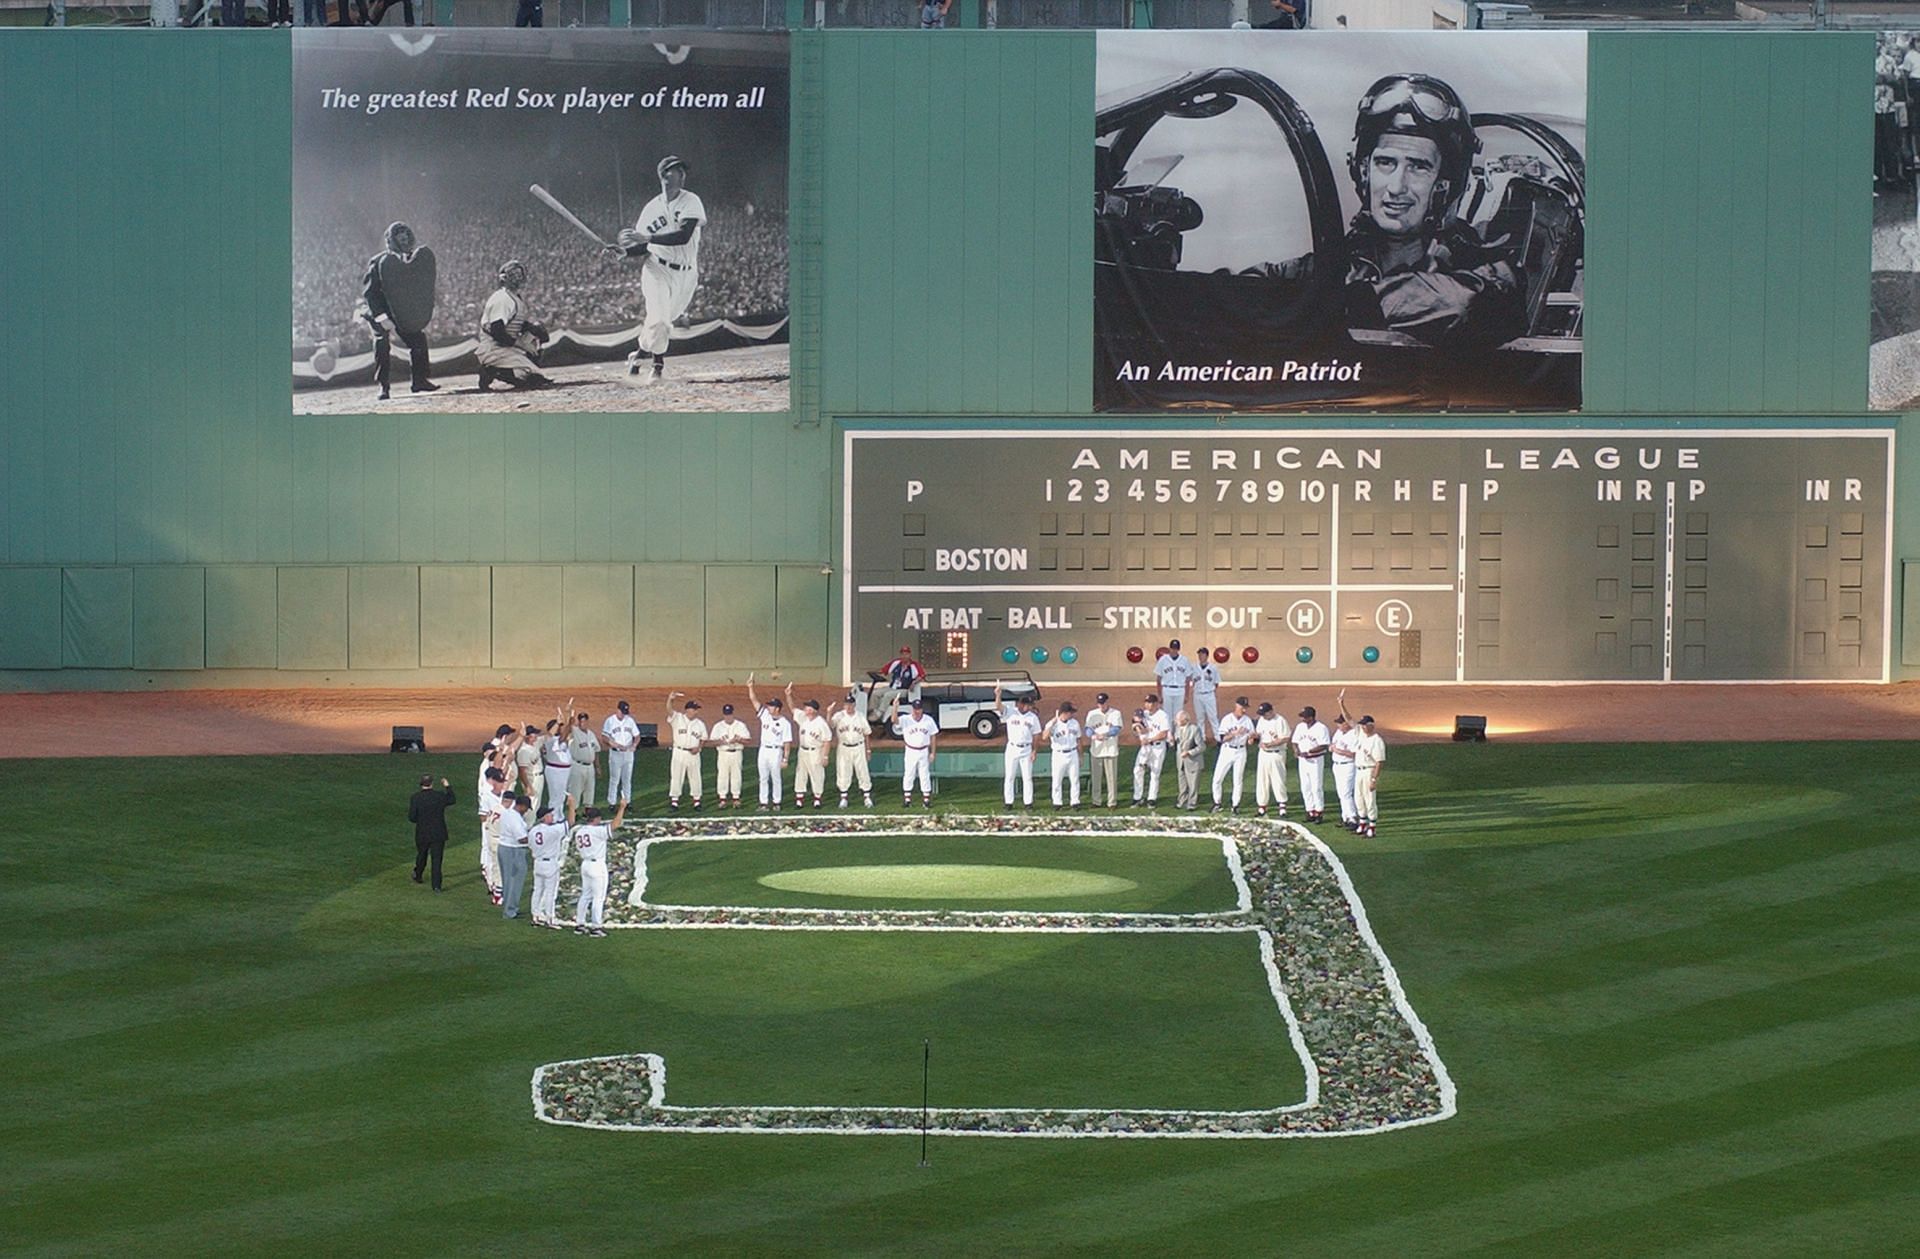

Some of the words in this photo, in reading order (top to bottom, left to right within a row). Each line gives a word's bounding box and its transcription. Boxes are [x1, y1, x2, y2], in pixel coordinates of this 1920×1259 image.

[320, 88, 361, 109] The
[366, 90, 459, 115] greatest
[465, 87, 510, 109] Red
[515, 87, 558, 109] Sox
[561, 87, 634, 115] player
[640, 87, 666, 109] of
[670, 87, 729, 109] them
[735, 87, 765, 109] all
[1116, 360, 1151, 382] An
[1156, 359, 1274, 382] American
[1281, 360, 1364, 382] Patriot
[1072, 446, 1382, 471] AMERICAN
[1485, 447, 1701, 470] LEAGUE
[907, 481, 924, 502] P
[1045, 479, 1053, 502] 1
[1067, 479, 1083, 502] 2
[1093, 479, 1110, 503] 3
[1126, 479, 1145, 502] 4
[1154, 479, 1171, 503] 5
[1179, 479, 1197, 503] 6
[1215, 479, 1233, 502] 7
[1241, 479, 1259, 503] 8
[1266, 479, 1285, 503] 9
[1300, 479, 1325, 503] 10
[1354, 480, 1372, 502] R
[1394, 480, 1411, 501] H
[1432, 479, 1448, 501] E
[1483, 479, 1499, 501] P
[1597, 479, 1622, 501] IN
[1636, 479, 1652, 501] R
[1689, 479, 1706, 501] P
[1806, 479, 1830, 501] IN
[1844, 479, 1862, 501] R
[935, 547, 1028, 572] BOSTON
[902, 607, 934, 630] AT
[940, 607, 983, 630] BAT
[1008, 606, 1072, 629] BALL
[1103, 606, 1193, 630] STRIKE
[1206, 606, 1263, 629] OUT
[946, 631, 970, 670] 9
[535, 831, 544, 846] 3
[576, 833, 592, 849] 33
